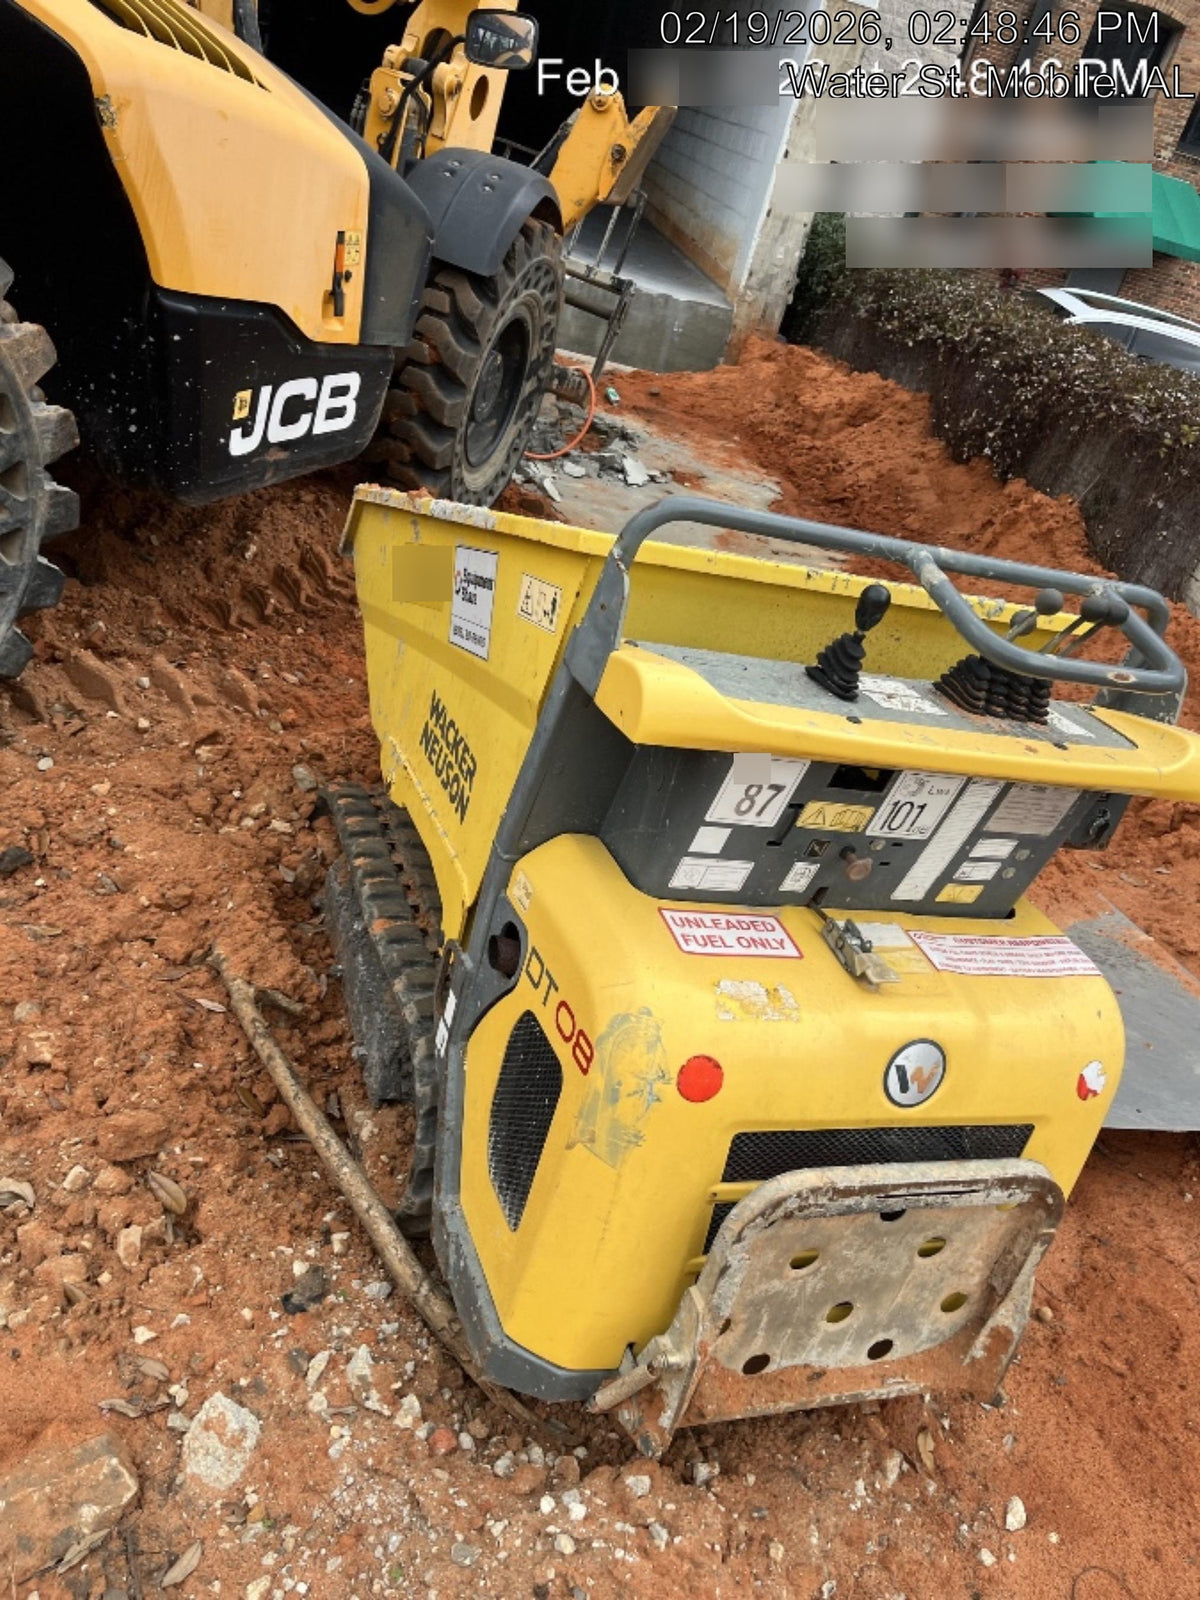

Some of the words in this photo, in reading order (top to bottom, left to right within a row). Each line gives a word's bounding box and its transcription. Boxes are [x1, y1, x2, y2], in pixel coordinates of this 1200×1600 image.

[229, 371, 361, 456] JCB
[430, 689, 477, 793] WACKER
[419, 720, 470, 826] NEUSON
[734, 784, 786, 817] 87
[880, 800, 928, 833] 101
[670, 915, 776, 932] UNLEADED
[680, 934, 734, 950] FUEL
[735, 936, 786, 951] ONLY
